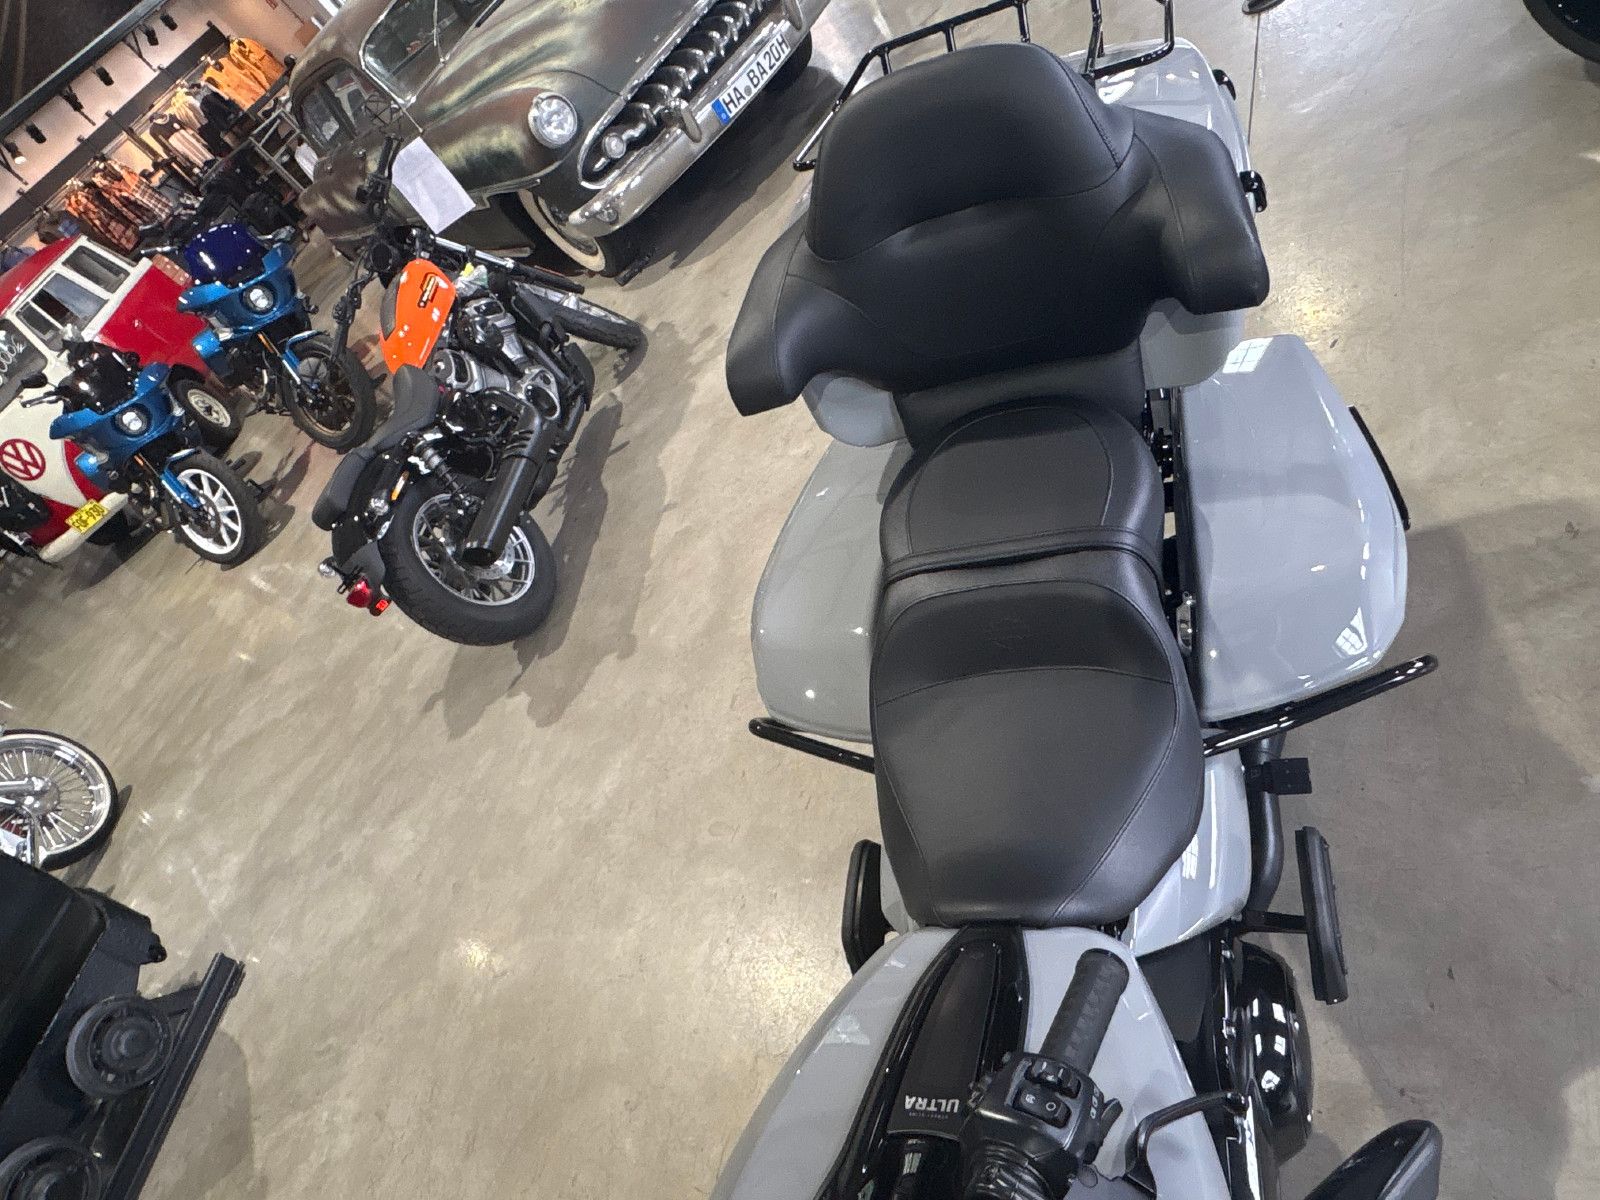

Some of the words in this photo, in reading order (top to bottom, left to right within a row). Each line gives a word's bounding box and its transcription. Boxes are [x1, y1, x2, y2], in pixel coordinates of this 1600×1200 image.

[721, 86, 746, 114] HA
[0, 438, 46, 481] VW
[904, 1094, 960, 1113] ULTRA
